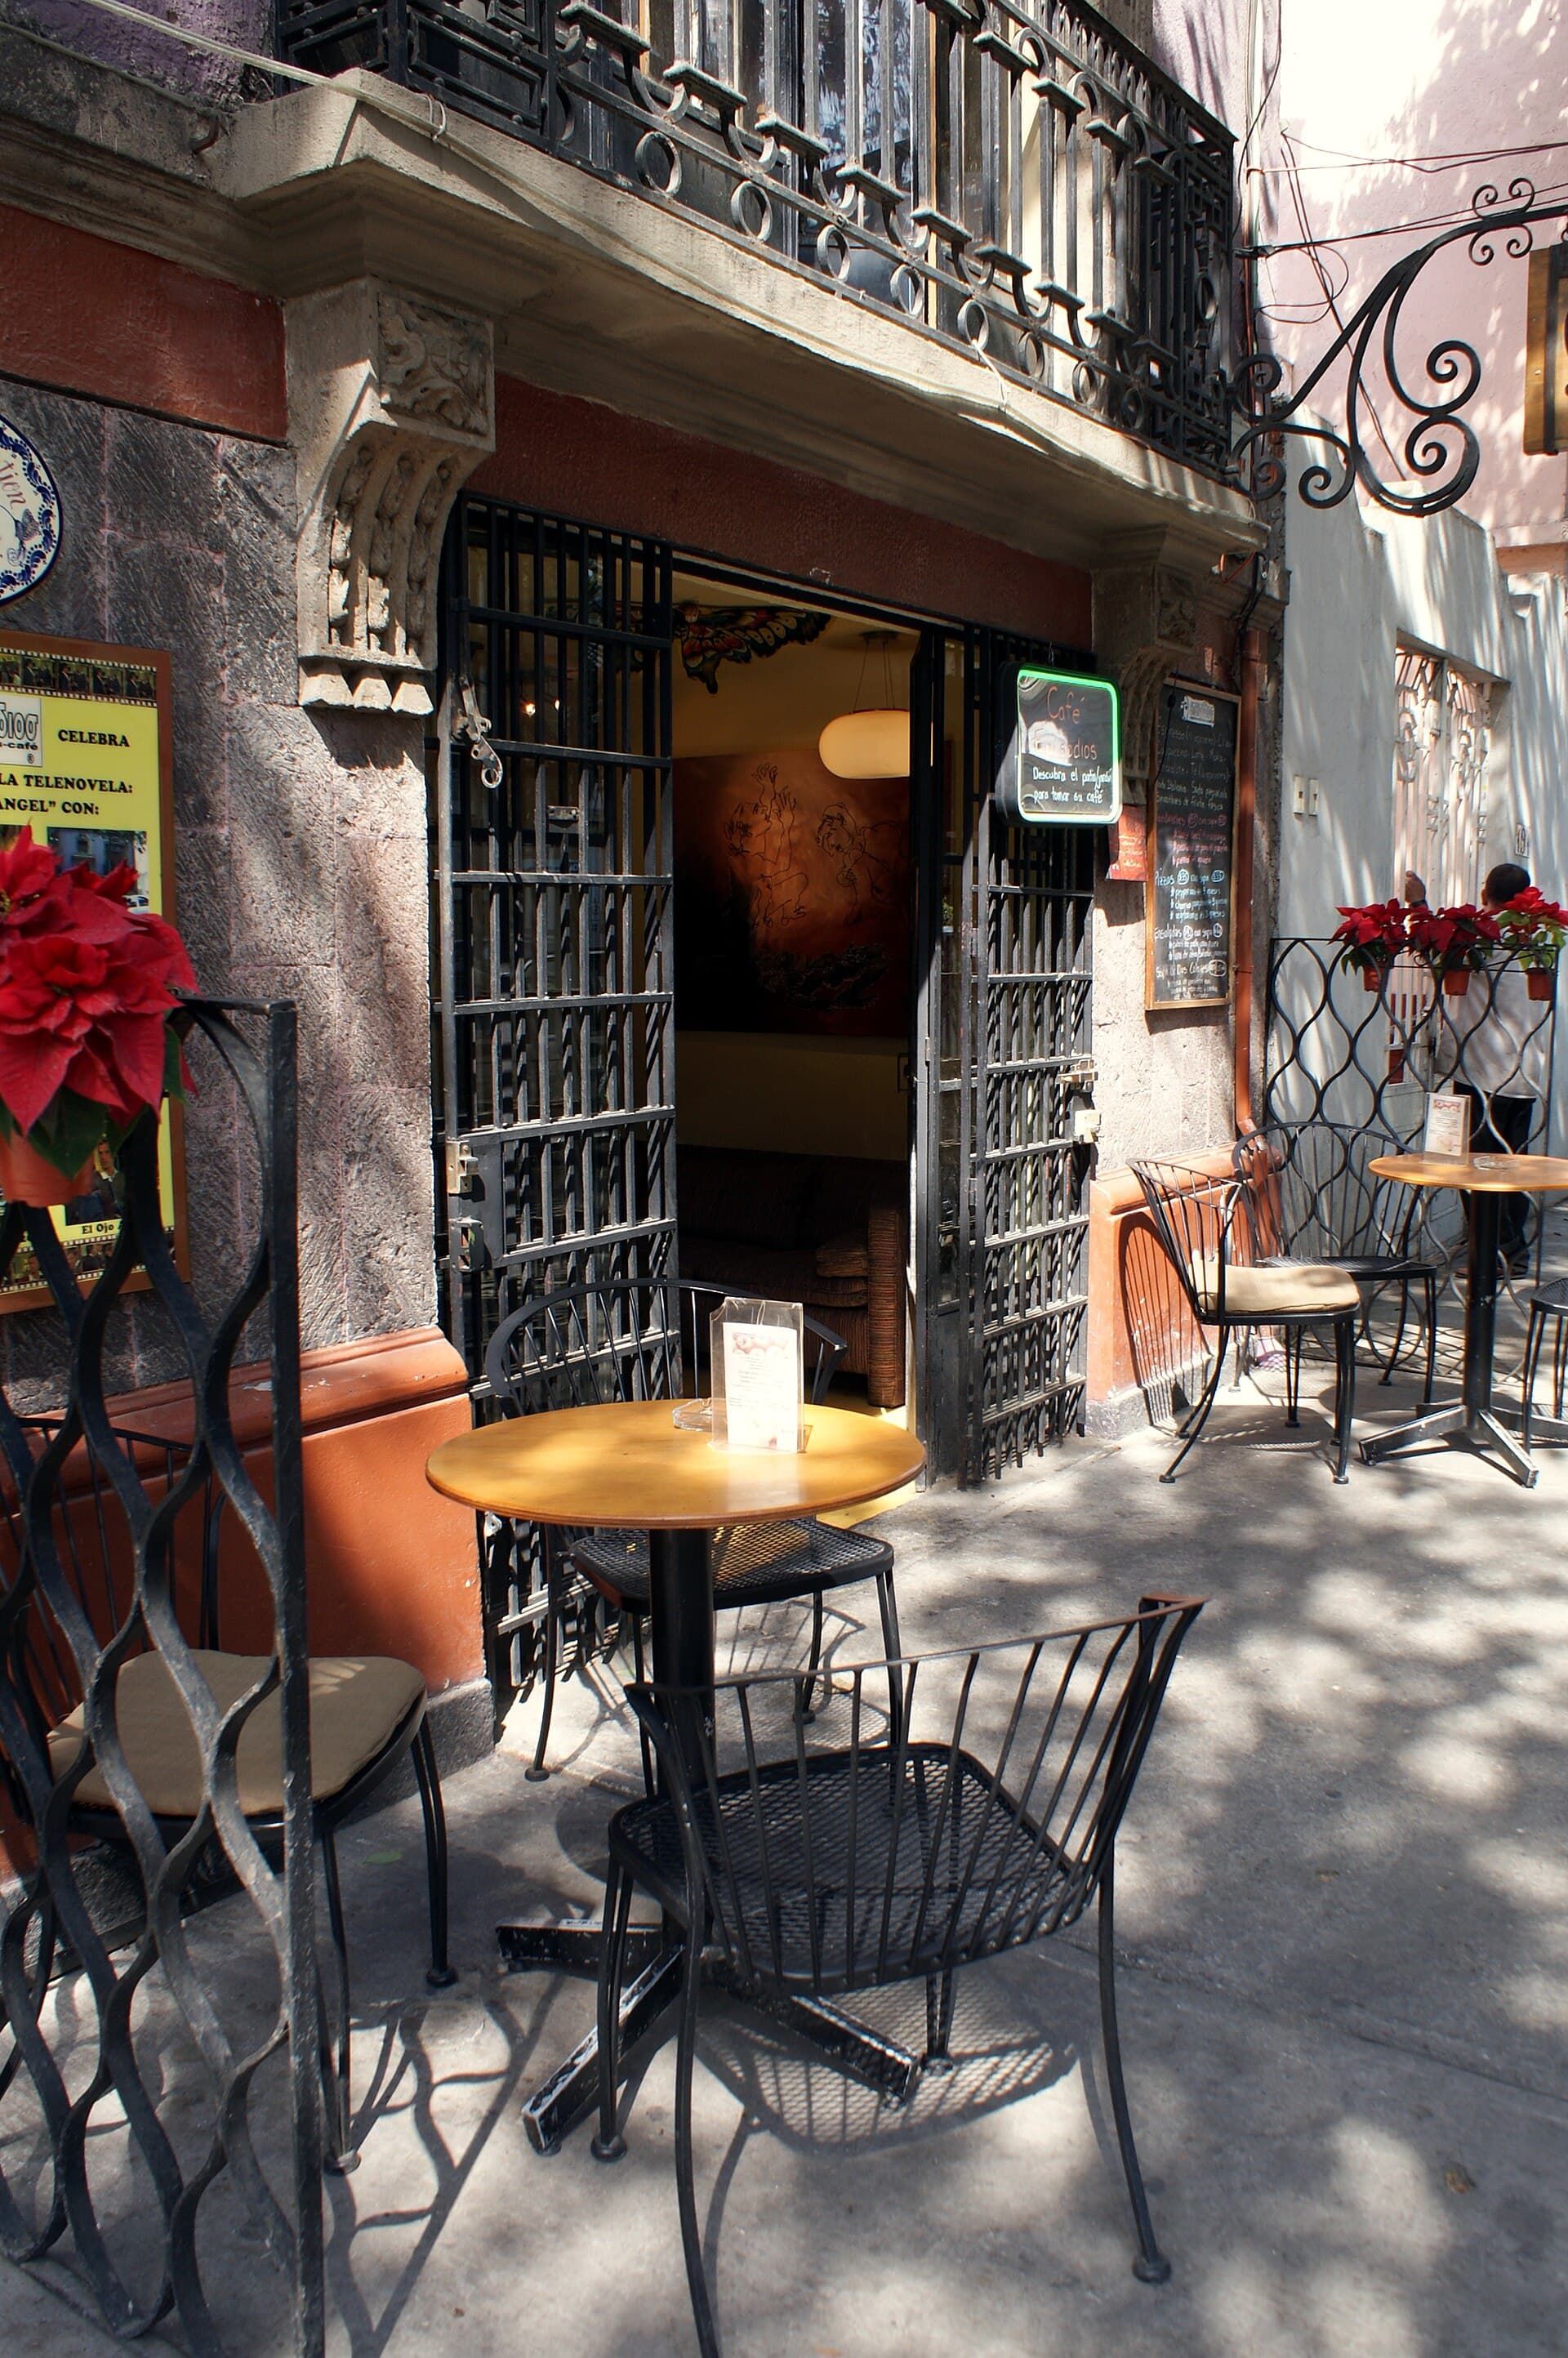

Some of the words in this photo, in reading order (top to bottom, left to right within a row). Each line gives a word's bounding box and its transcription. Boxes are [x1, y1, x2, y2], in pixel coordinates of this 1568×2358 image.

[1047, 686, 1085, 724] Café
[58, 729, 130, 747] CELEBRA
[1032, 766, 1066, 782] Descubra
[1071, 767, 1078, 781] el
[24, 774, 133, 793] TELENOVELA:
[1034, 790, 1049, 804] para
[1051, 787, 1070, 801] tomar
[1073, 791, 1083, 802] su
[1086, 790, 1104, 804] café
[61, 801, 100, 815] CON:
[1155, 868, 1175, 886] Pizzas
[82, 1226, 93, 1235] El
[96, 1224, 114, 1233] Ojo
